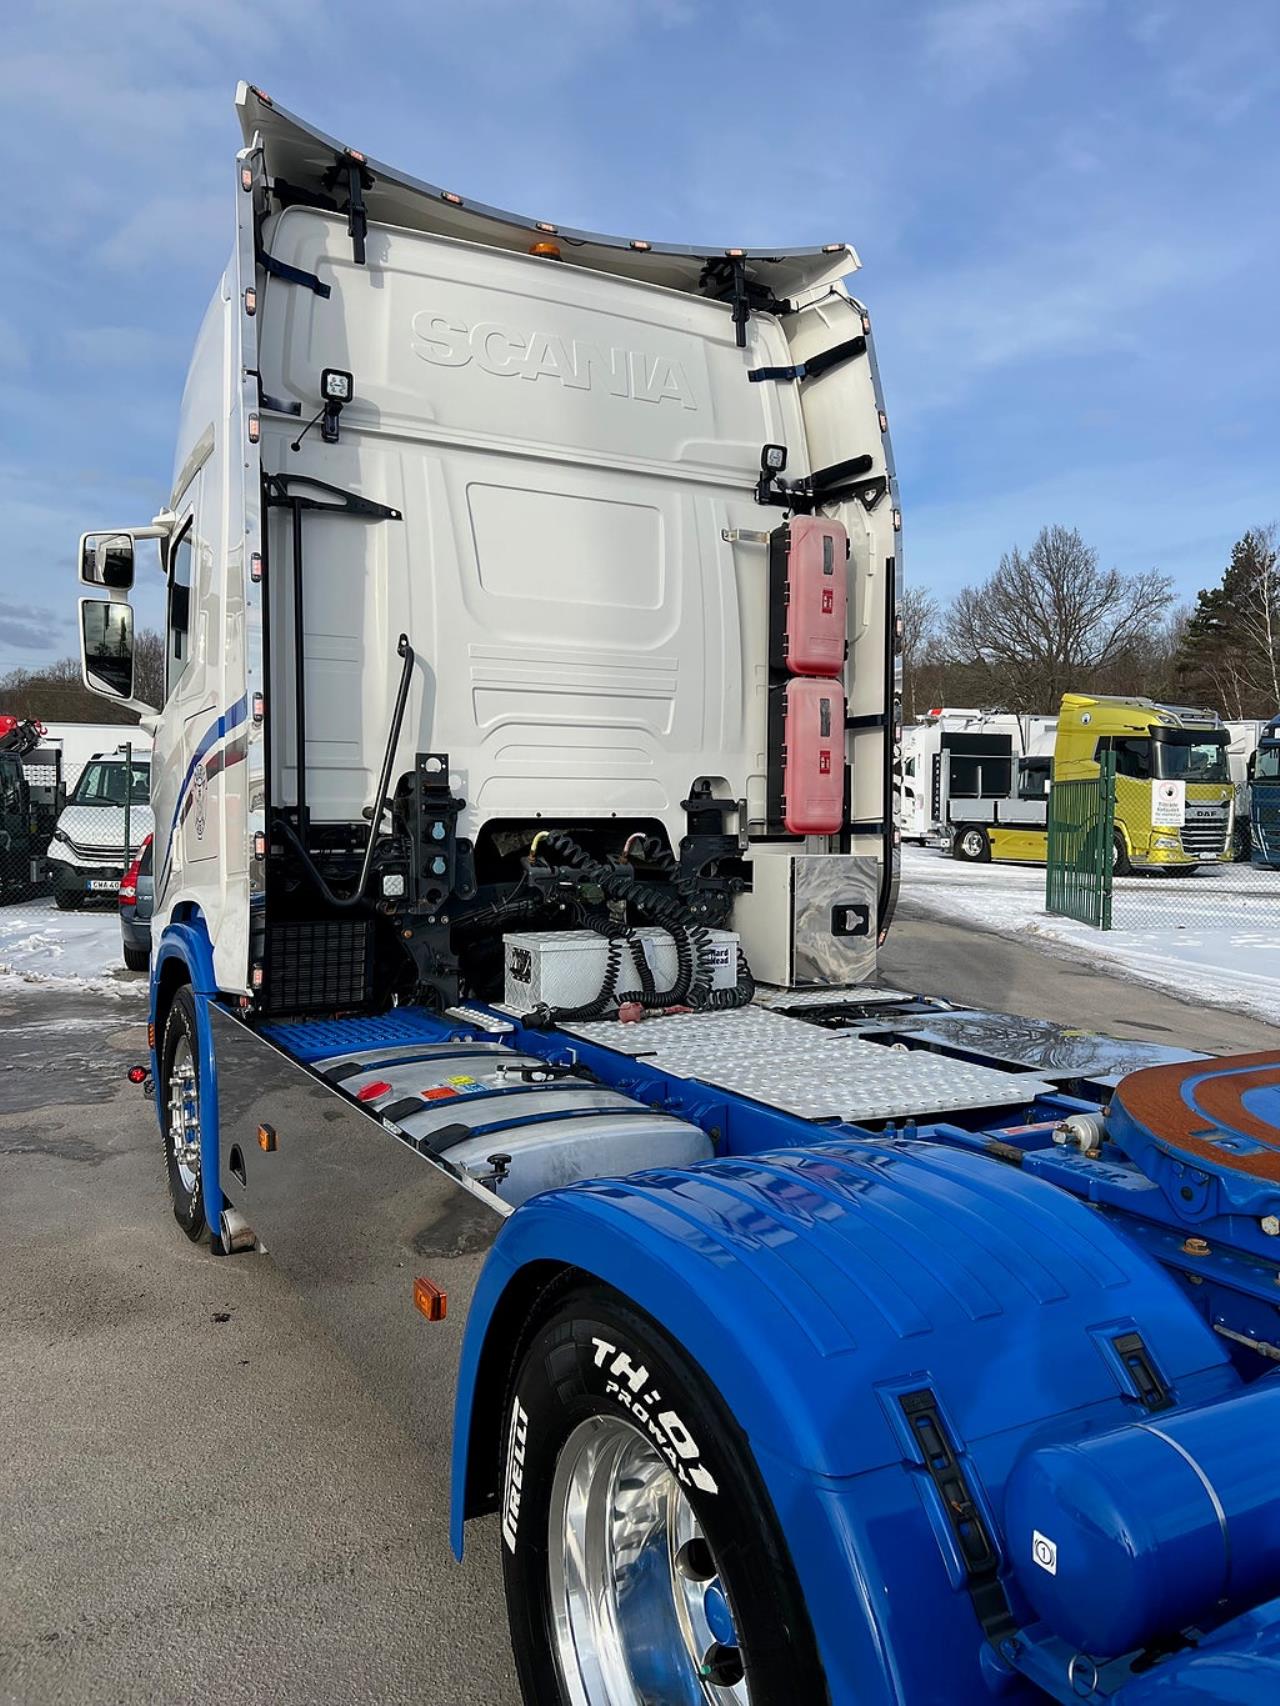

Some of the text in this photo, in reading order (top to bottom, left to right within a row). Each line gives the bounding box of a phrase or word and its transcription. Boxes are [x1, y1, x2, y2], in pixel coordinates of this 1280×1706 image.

[410, 310, 698, 411] SCANIA
[502, 1396, 530, 1554] PIRELLI
[605, 1380, 692, 1487] PROWAY
